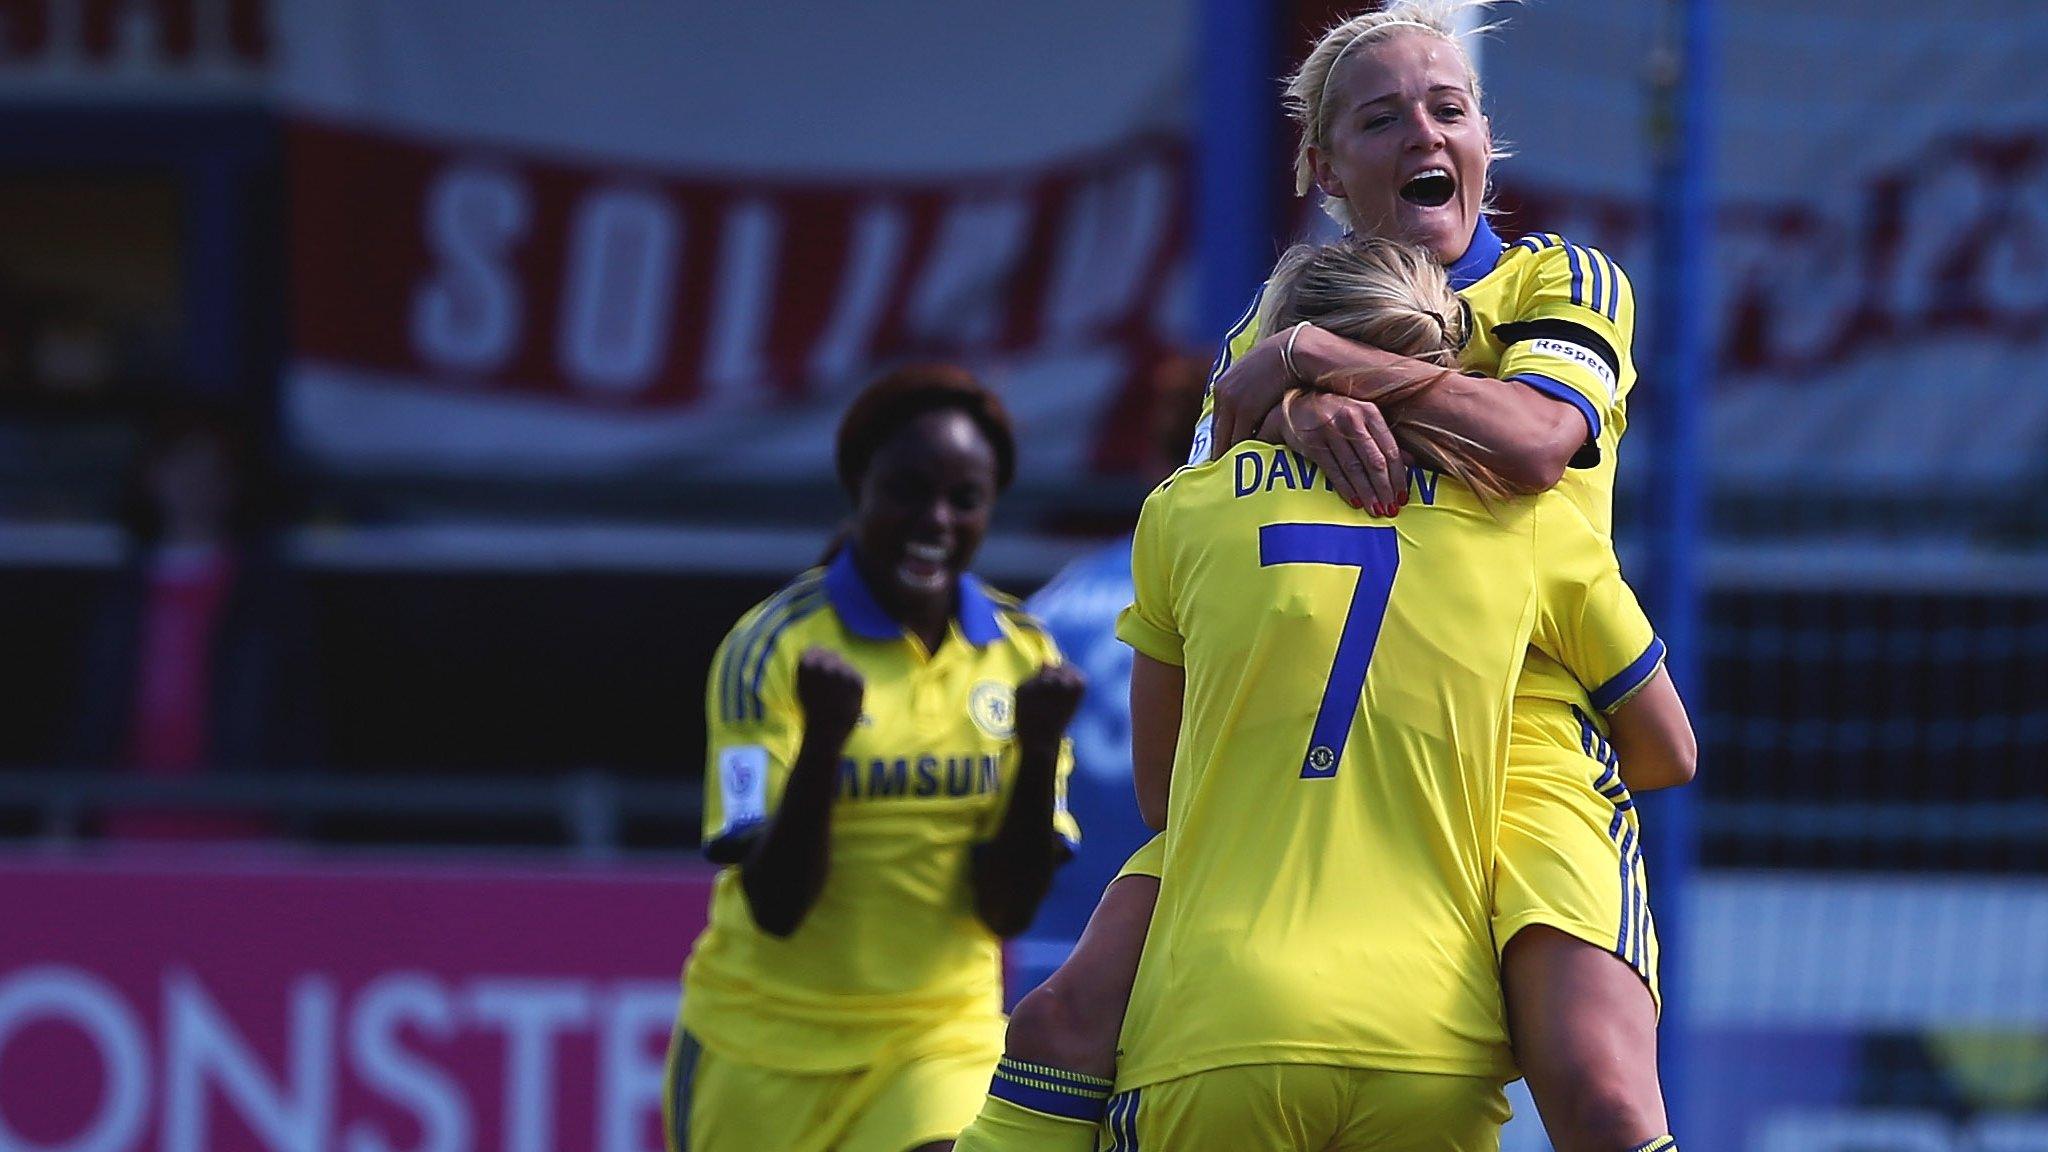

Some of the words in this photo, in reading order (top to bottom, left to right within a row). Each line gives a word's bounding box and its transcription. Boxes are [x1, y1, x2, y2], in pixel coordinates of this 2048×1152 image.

[1535, 339, 1610, 383] Respect
[1235, 449, 1440, 506] DAVN
[1259, 522, 1400, 779] 7
